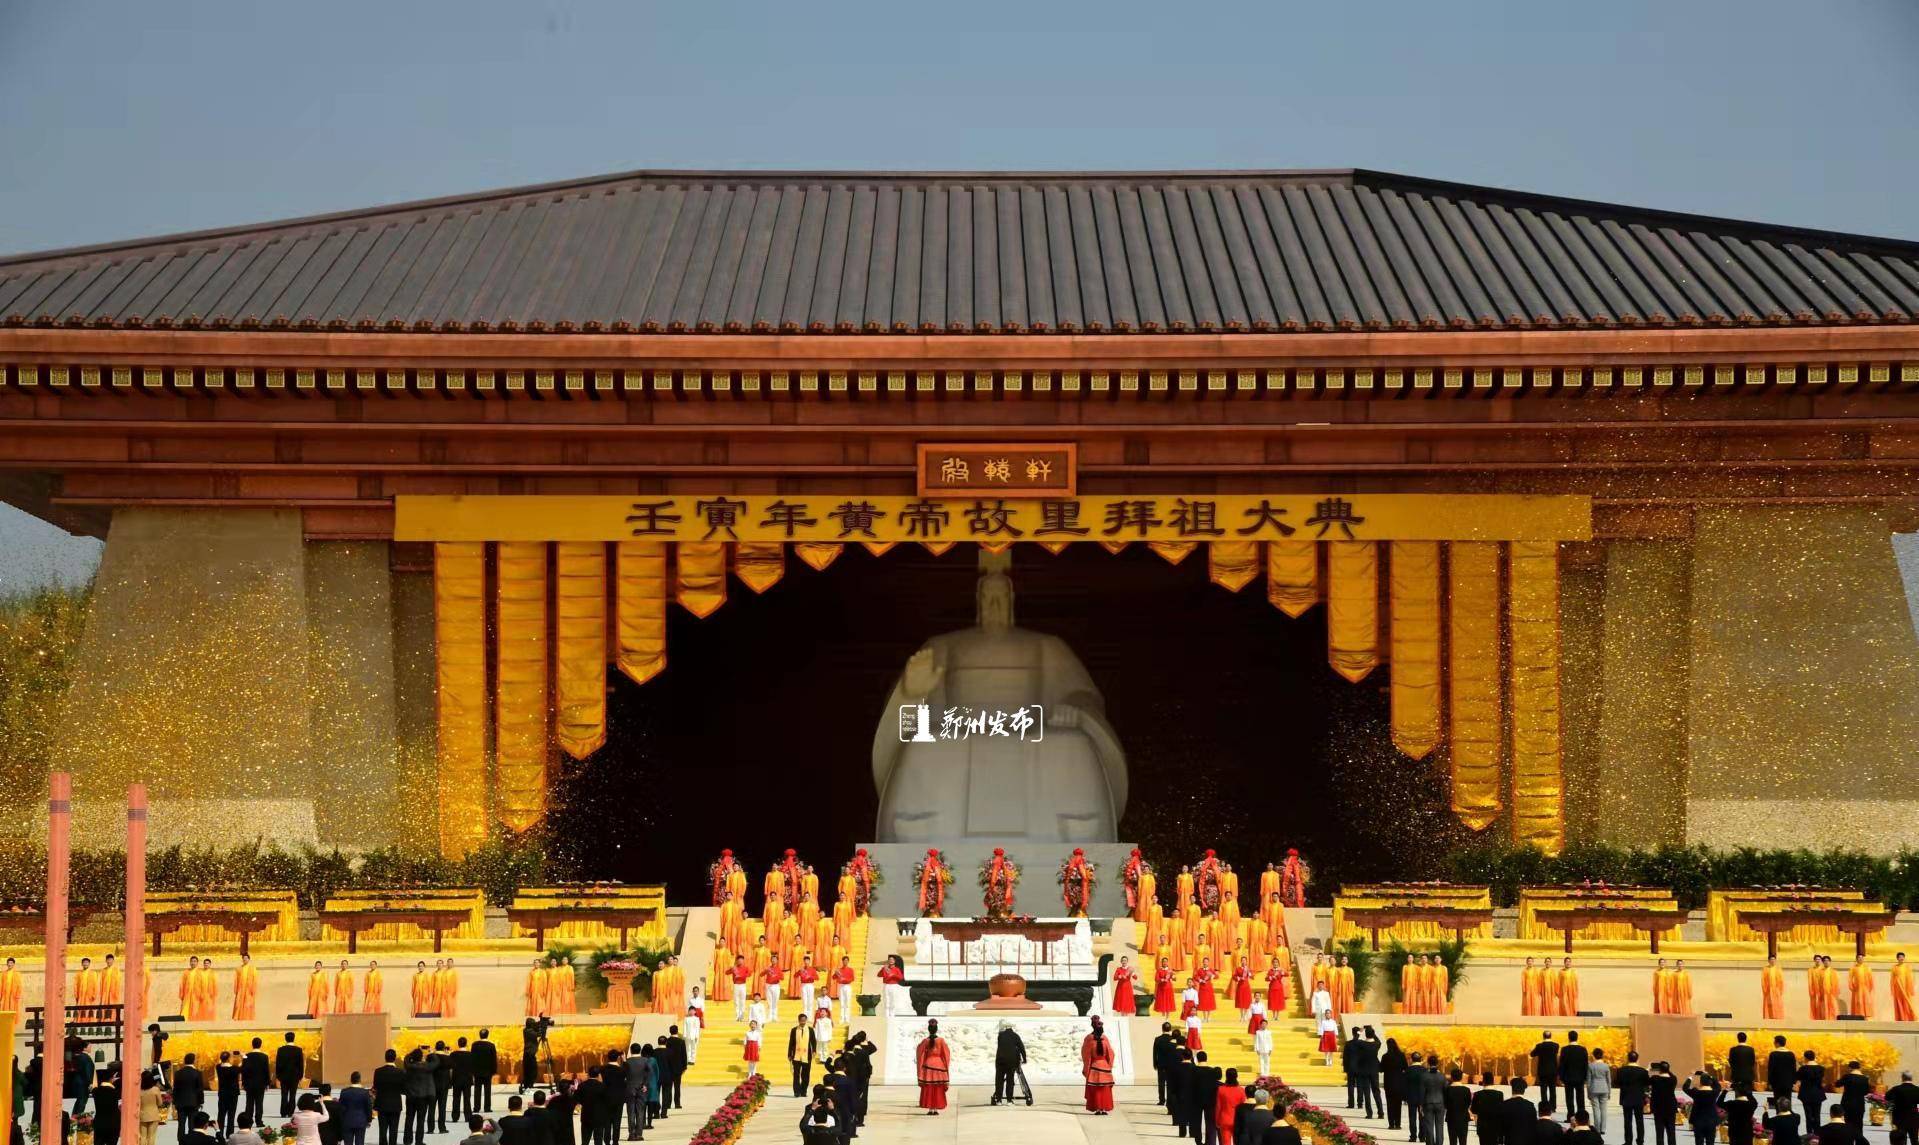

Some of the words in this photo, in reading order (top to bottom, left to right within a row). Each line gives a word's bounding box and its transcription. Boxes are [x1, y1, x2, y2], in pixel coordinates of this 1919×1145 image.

[626, 497, 1365, 540] 壬寅年黄帝故里拜祖大典
